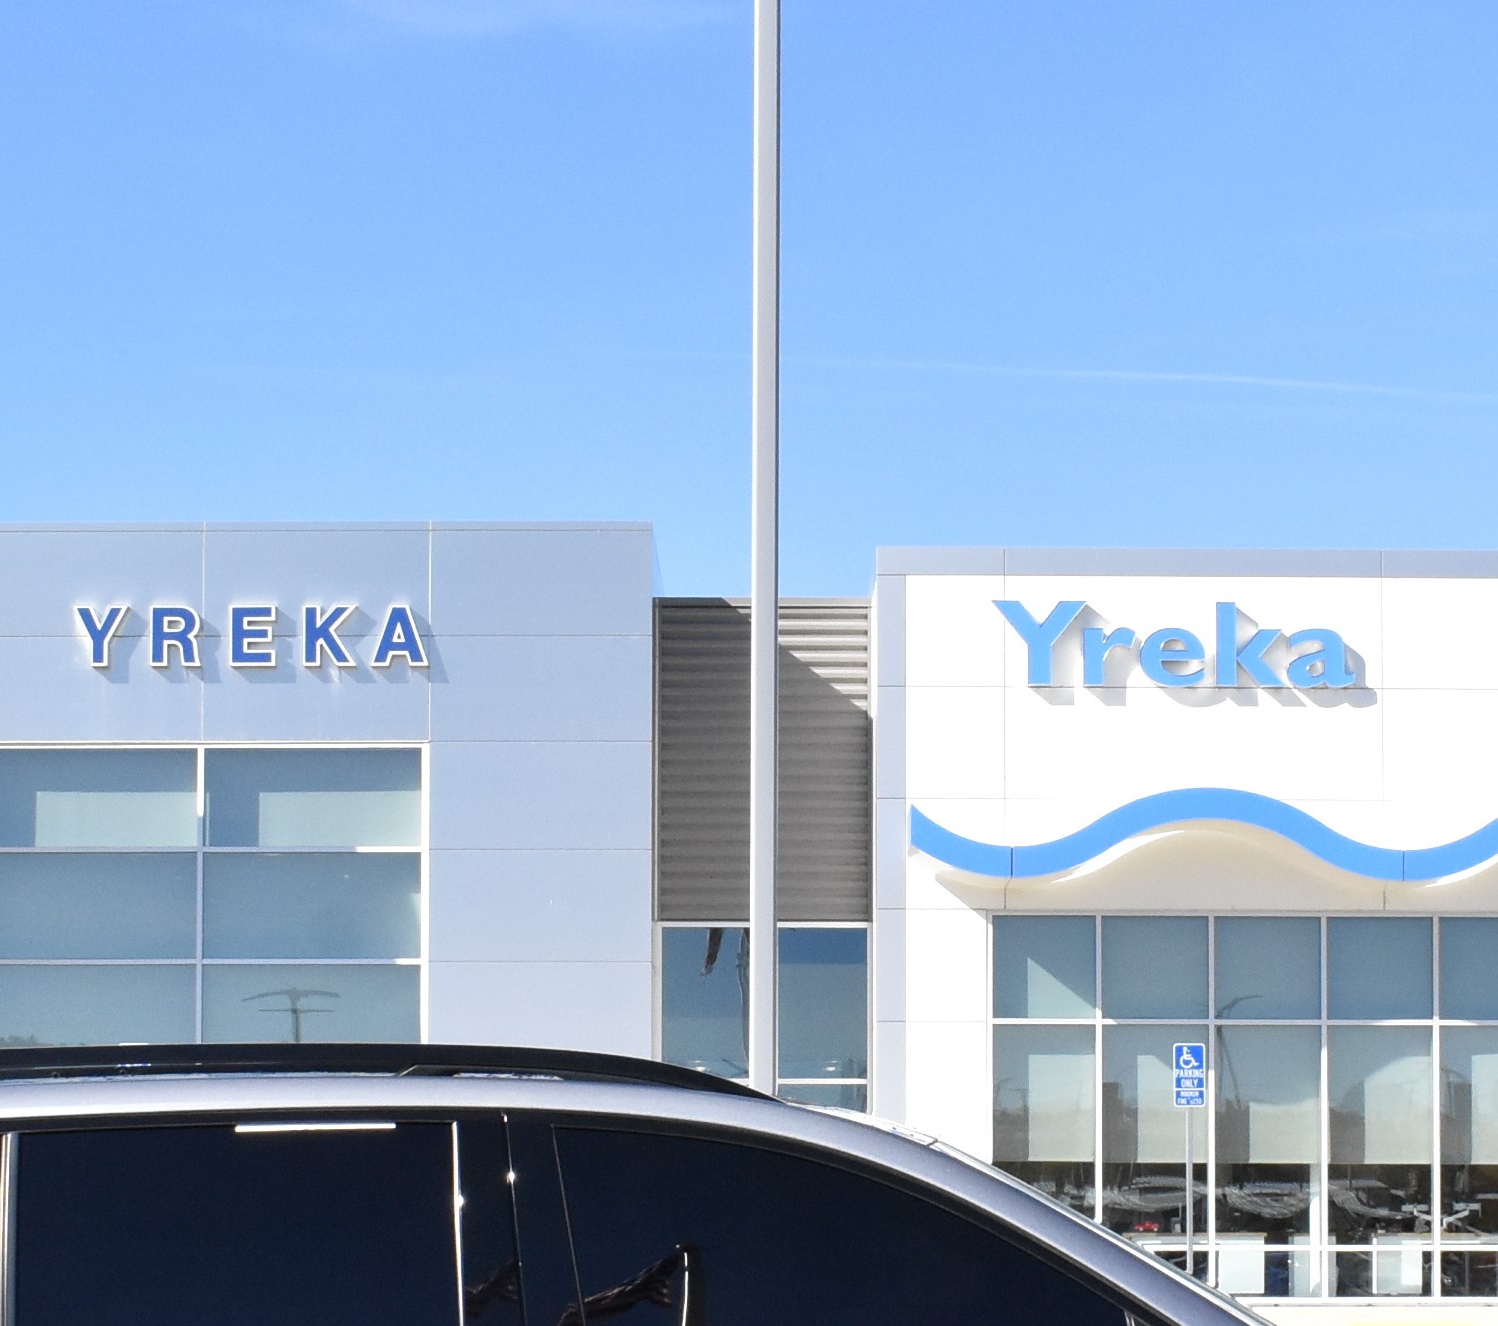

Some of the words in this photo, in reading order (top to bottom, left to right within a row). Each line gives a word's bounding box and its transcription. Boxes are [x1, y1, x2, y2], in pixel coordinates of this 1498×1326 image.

[73, 604, 430, 667] YREKA
[991, 599, 1357, 688] Yreka
[1175, 1068, 1204, 1078] PARKING
[1181, 1078, 1199, 1088] ONLY
